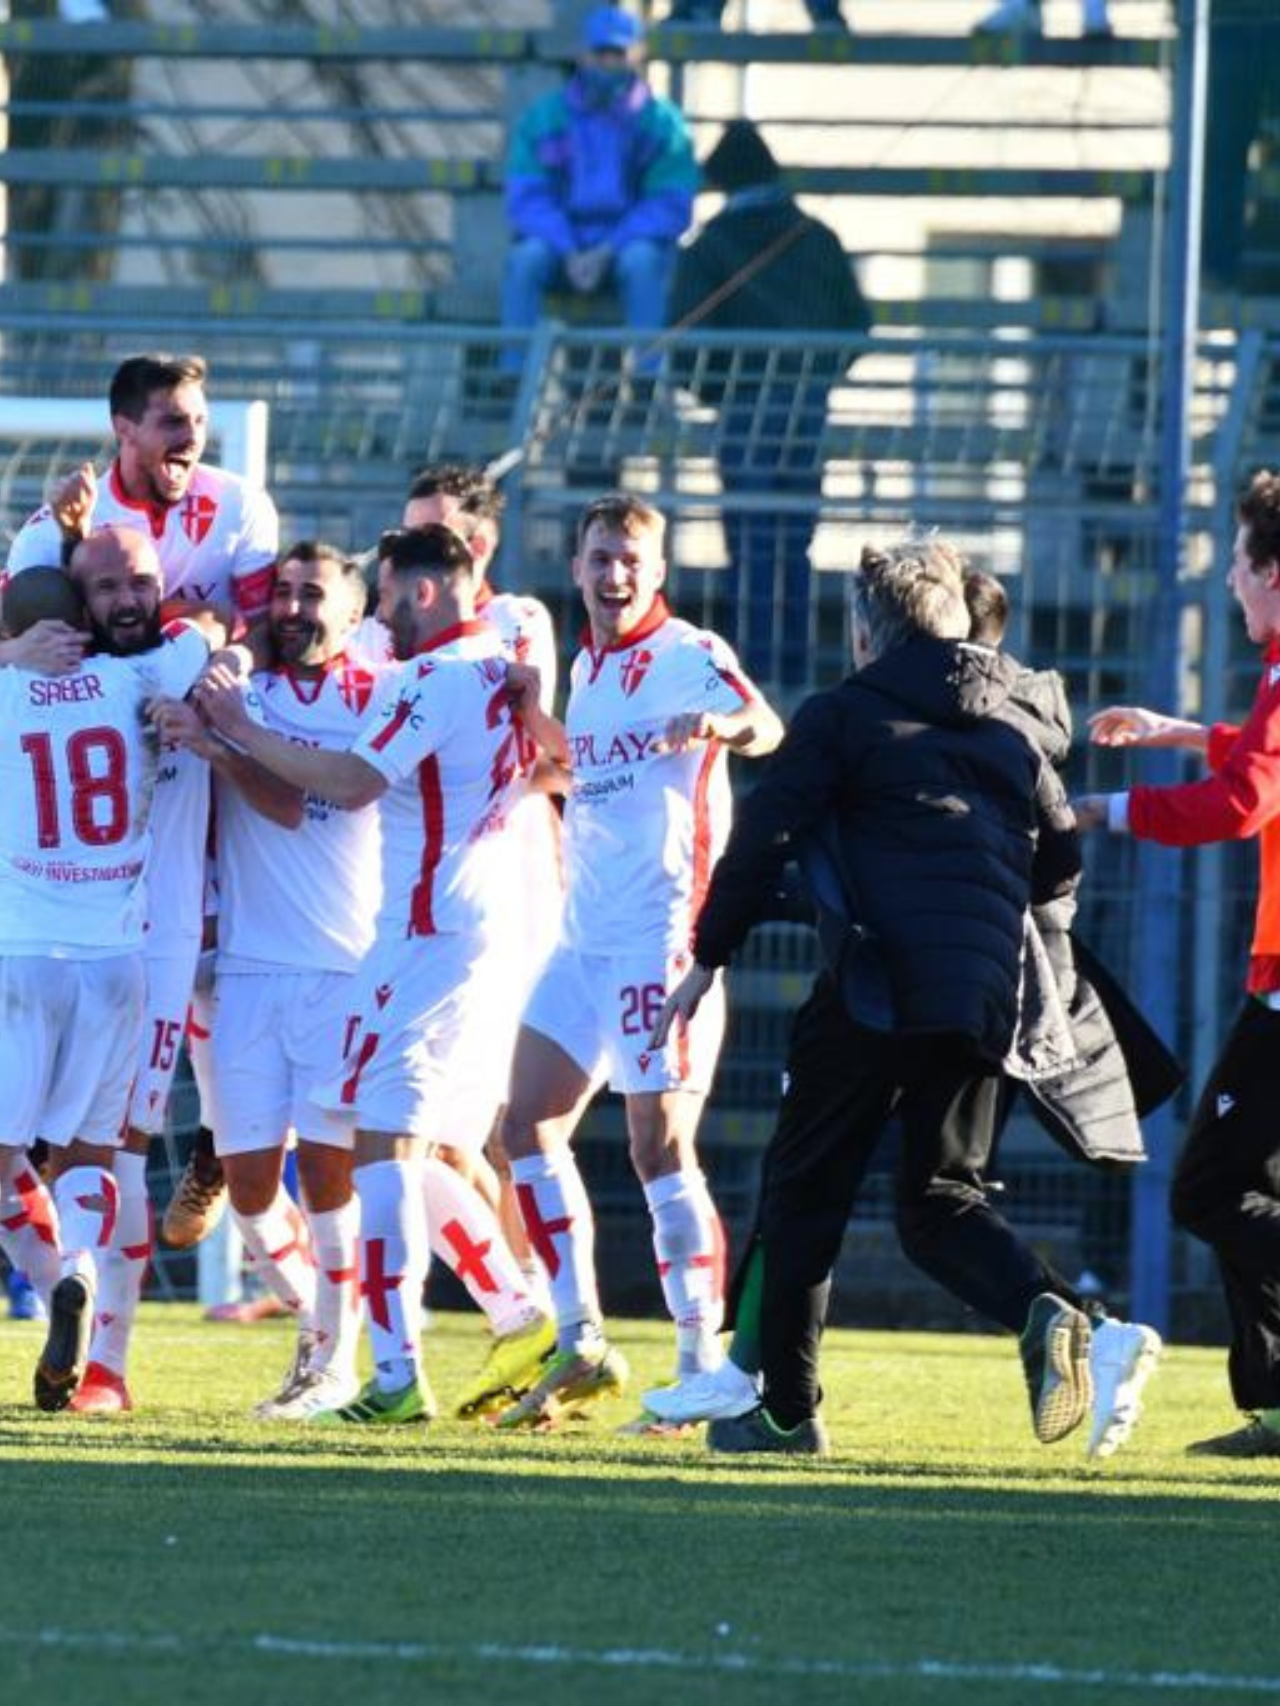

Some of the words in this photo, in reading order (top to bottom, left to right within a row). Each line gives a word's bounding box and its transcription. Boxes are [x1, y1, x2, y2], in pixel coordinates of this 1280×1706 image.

[19, 725, 129, 849] 18
[619, 983, 666, 1035] 26
[149, 1018, 181, 1072] 15
